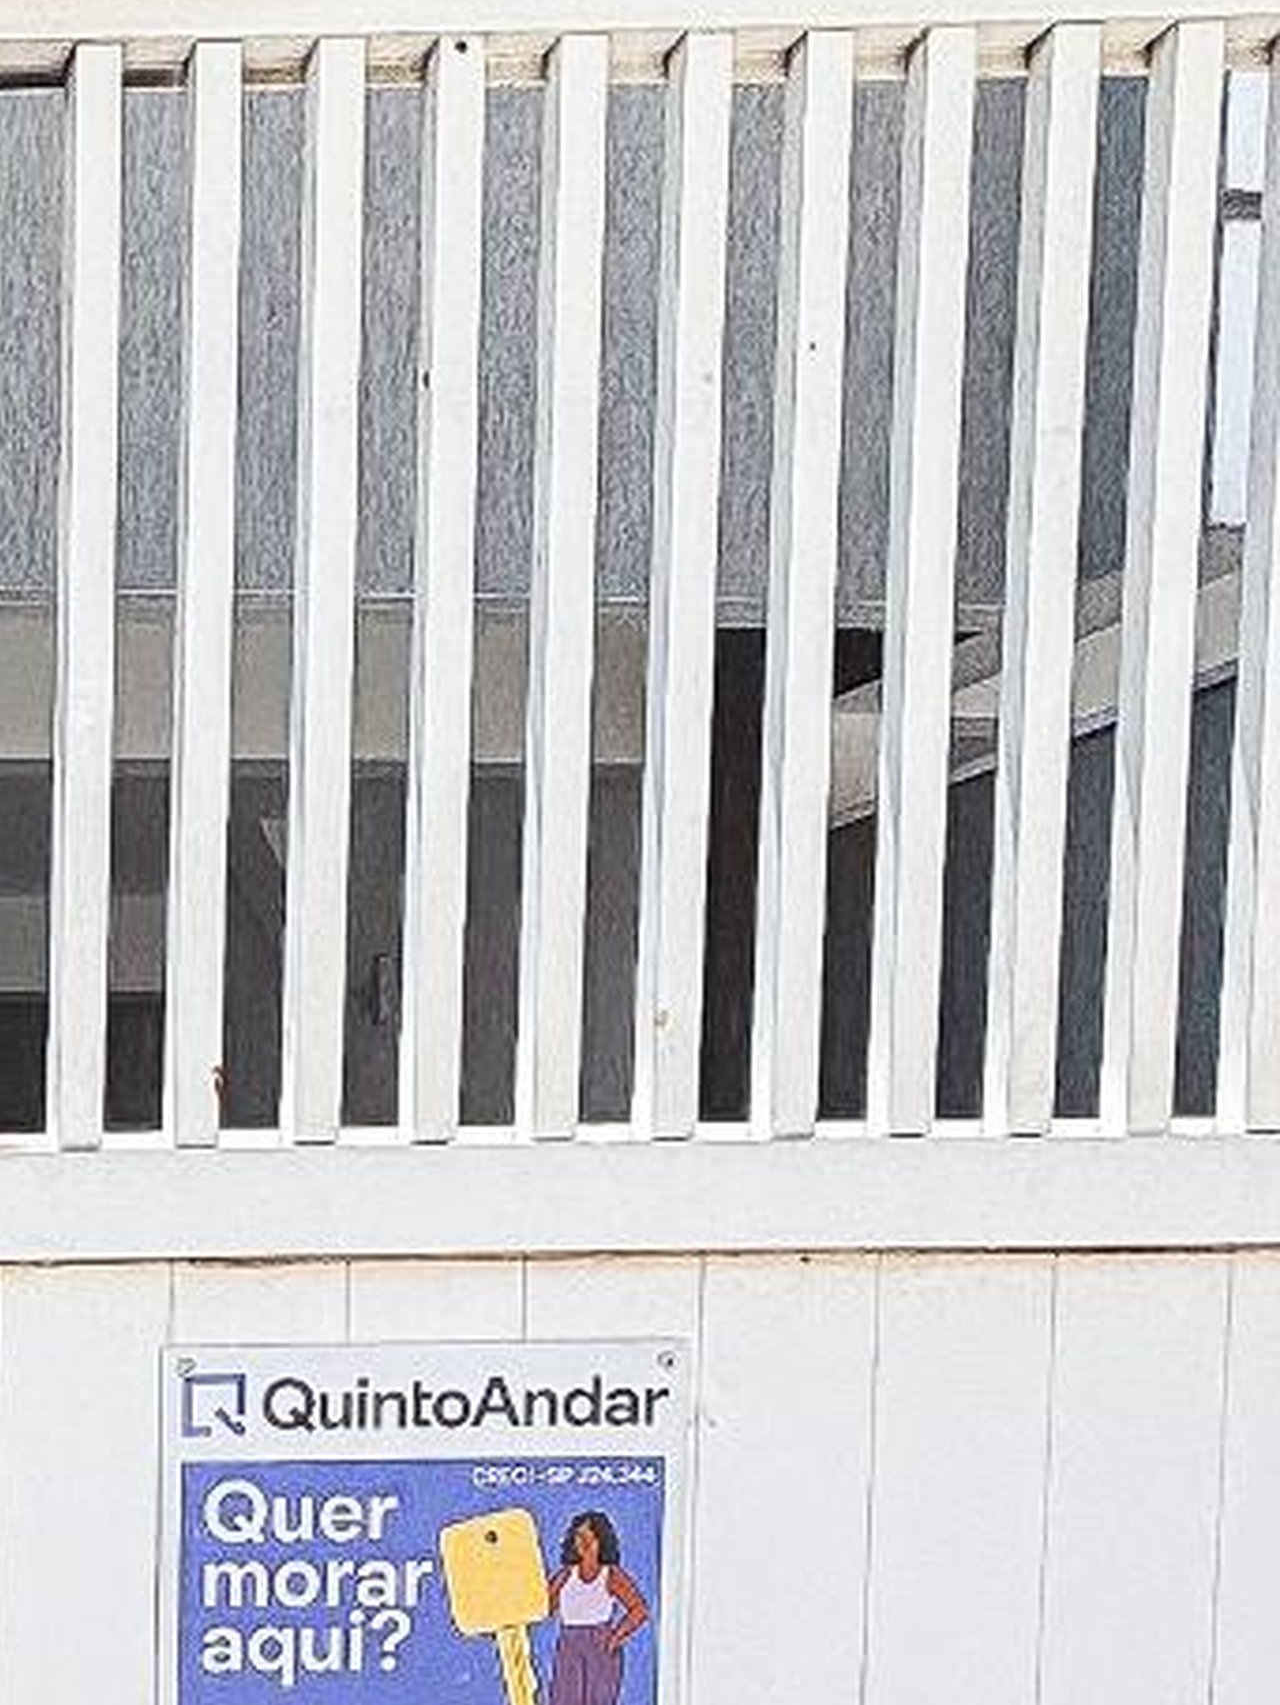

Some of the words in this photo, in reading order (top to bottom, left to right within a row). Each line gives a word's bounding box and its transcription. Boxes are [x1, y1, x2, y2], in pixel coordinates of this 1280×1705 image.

[262, 1375, 669, 1433] QuintoAndar
[201, 1479, 397, 1544] Quer
[202, 1557, 432, 1607] morar
[201, 1608, 411, 1686] aqui?
